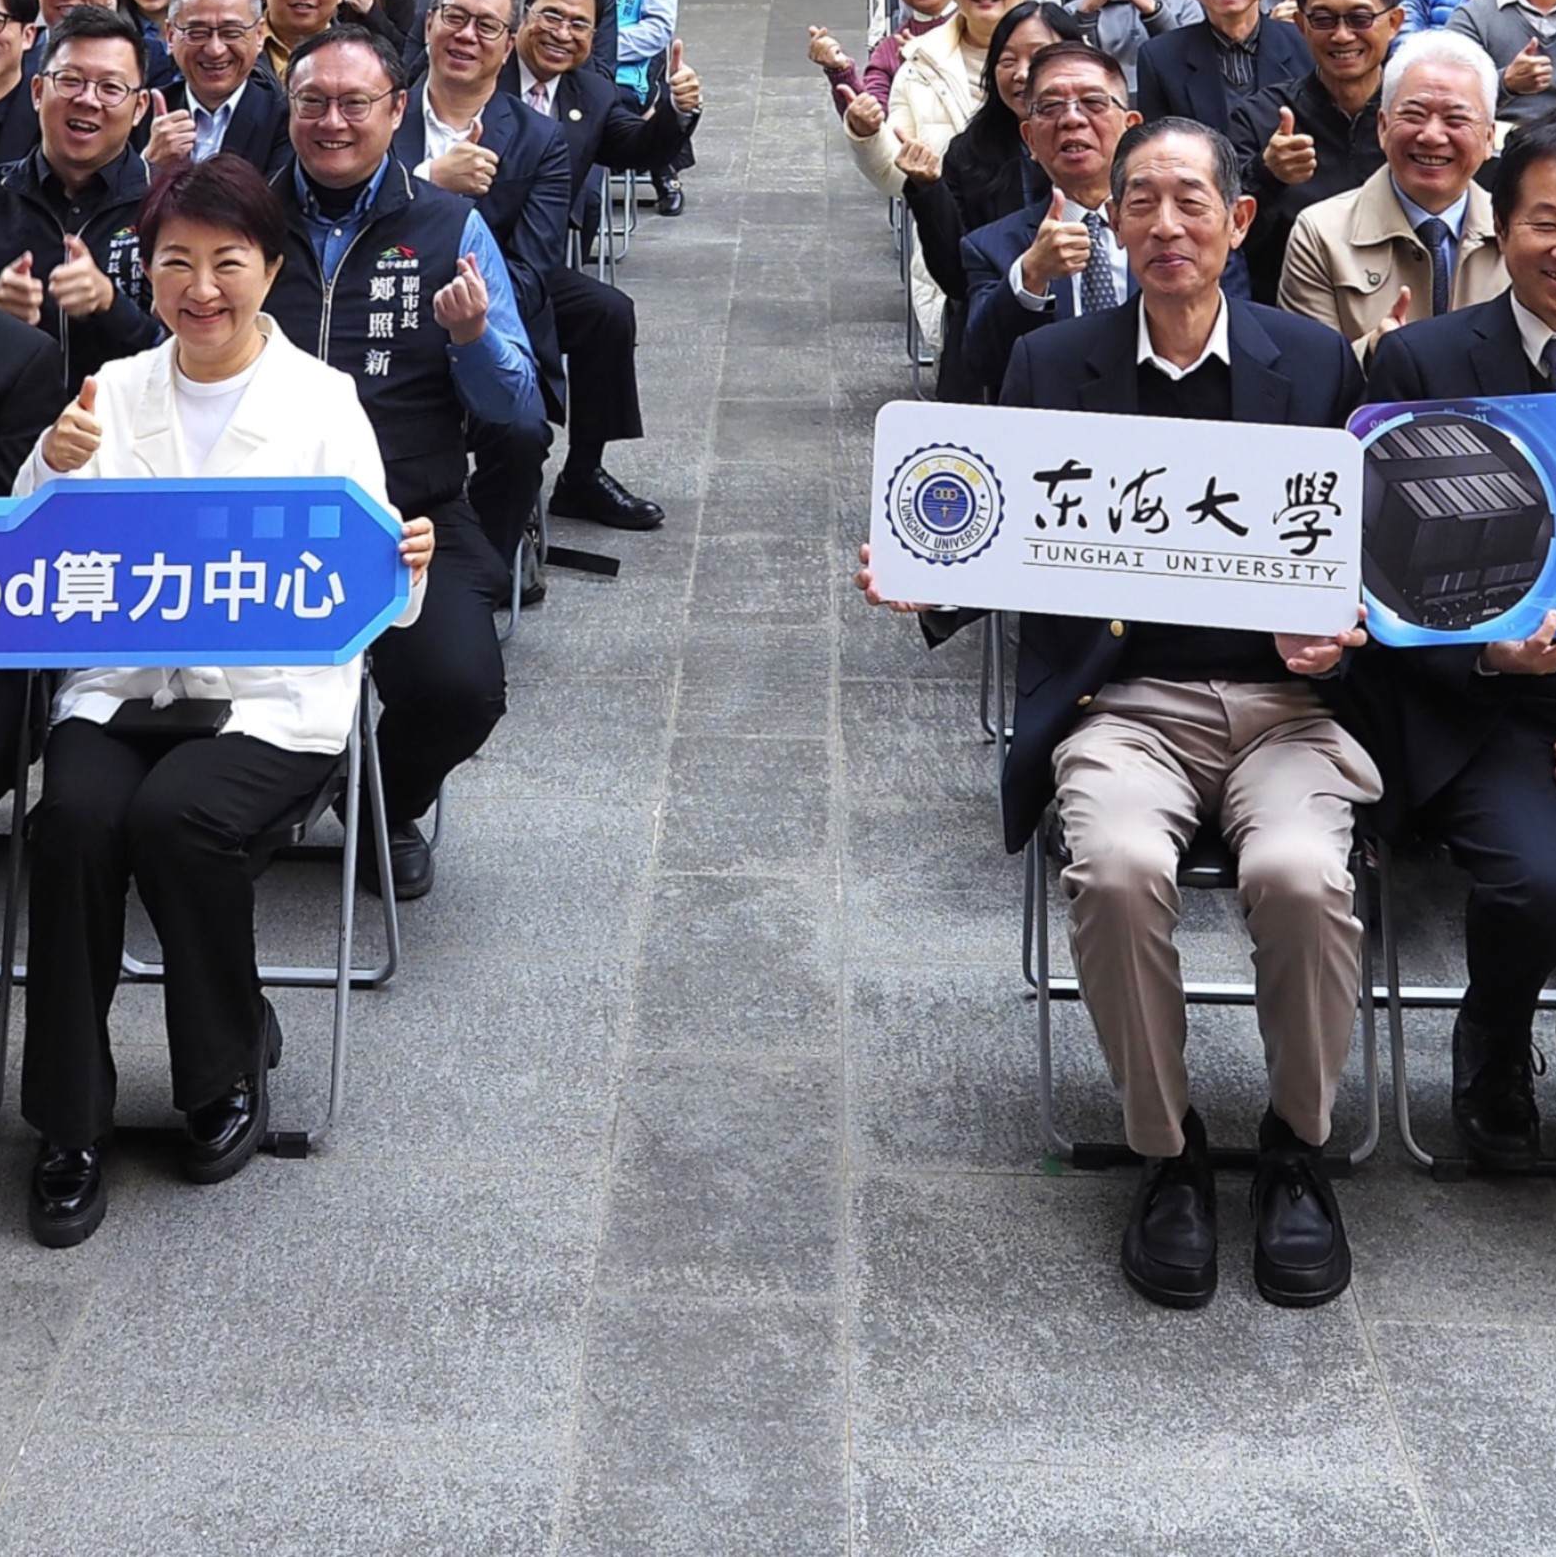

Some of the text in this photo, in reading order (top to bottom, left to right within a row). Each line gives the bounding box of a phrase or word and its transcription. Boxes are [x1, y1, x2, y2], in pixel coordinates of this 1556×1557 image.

[364, 275, 397, 377] 鄭照新
[400, 275, 420, 330] 副市長
[900, 497, 990, 550] TUNGHAI UNIVERSITY
[1029, 543, 1339, 583] TUNGHAI UNIVERSITY
